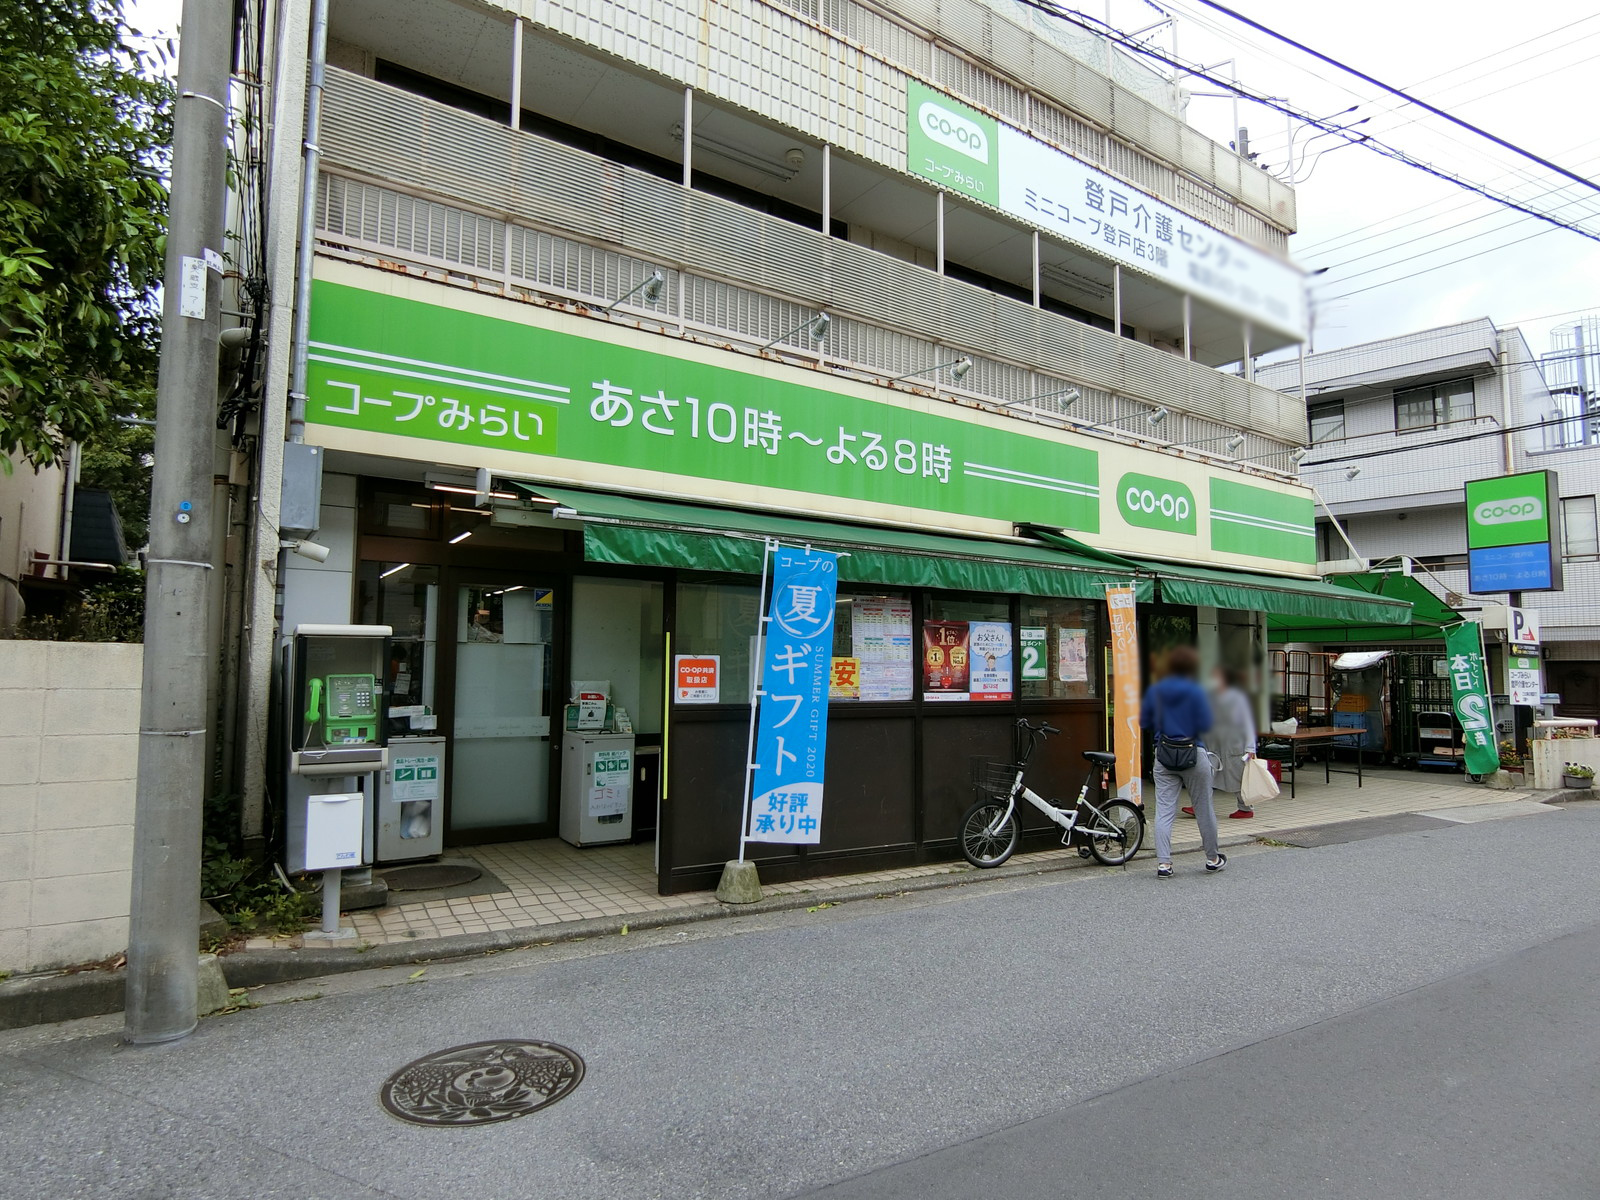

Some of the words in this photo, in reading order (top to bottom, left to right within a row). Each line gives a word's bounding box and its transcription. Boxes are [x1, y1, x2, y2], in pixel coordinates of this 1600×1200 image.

[925, 157, 985, 192] コープみらい
[325, 379, 543, 441] コープみらい
[780, 556, 834, 574] コープの
[784, 584, 823, 624] 夏
[1513, 610, 1524, 640] P
[811, 646, 824, 703] SUMMER
[830, 660, 856, 686] 安
[1022, 646, 1041, 677] 2
[686, 676, 708, 684] 取扱店
[771, 642, 812, 777] ギフト
[809, 708, 820, 741] GIFT
[805, 746, 817, 777] 2020
[768, 792, 809, 814] 好評
[755, 814, 817, 836] 承り中
